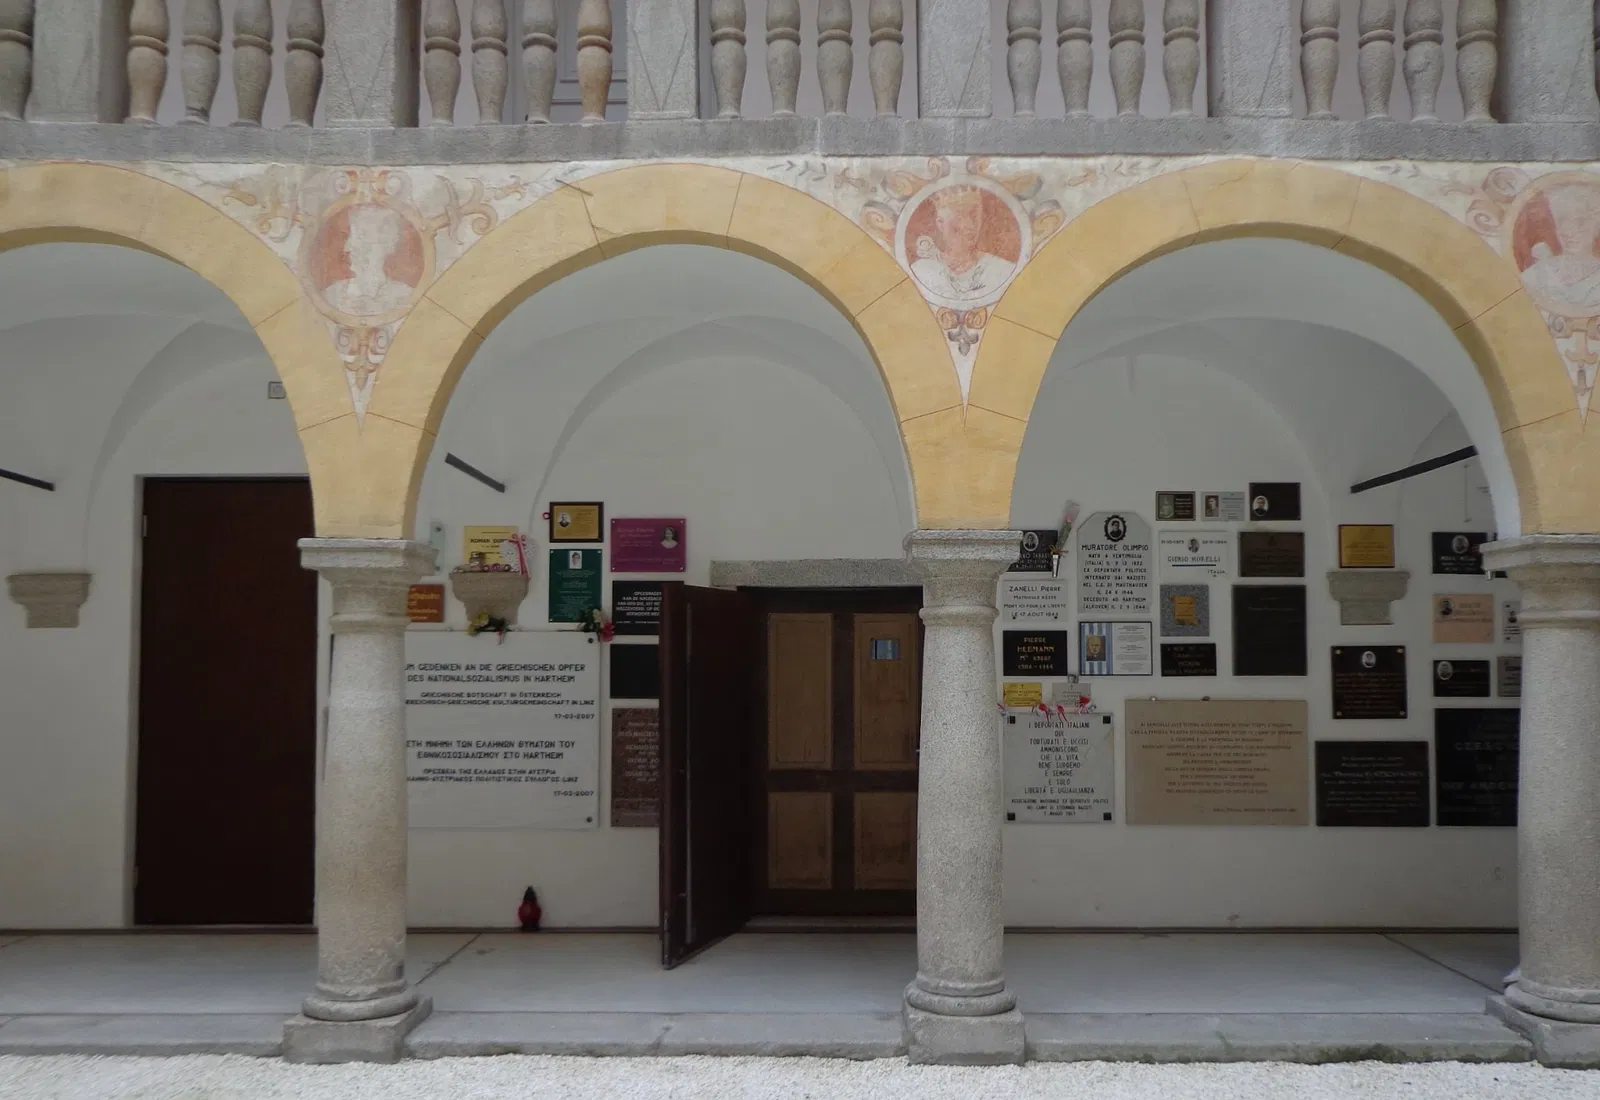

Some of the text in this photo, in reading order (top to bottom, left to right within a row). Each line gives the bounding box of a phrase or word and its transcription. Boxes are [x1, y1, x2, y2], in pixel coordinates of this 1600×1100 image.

[408, 675, 575, 683] DES NATIONALSOZIALISMUS IN HARTHEIM
